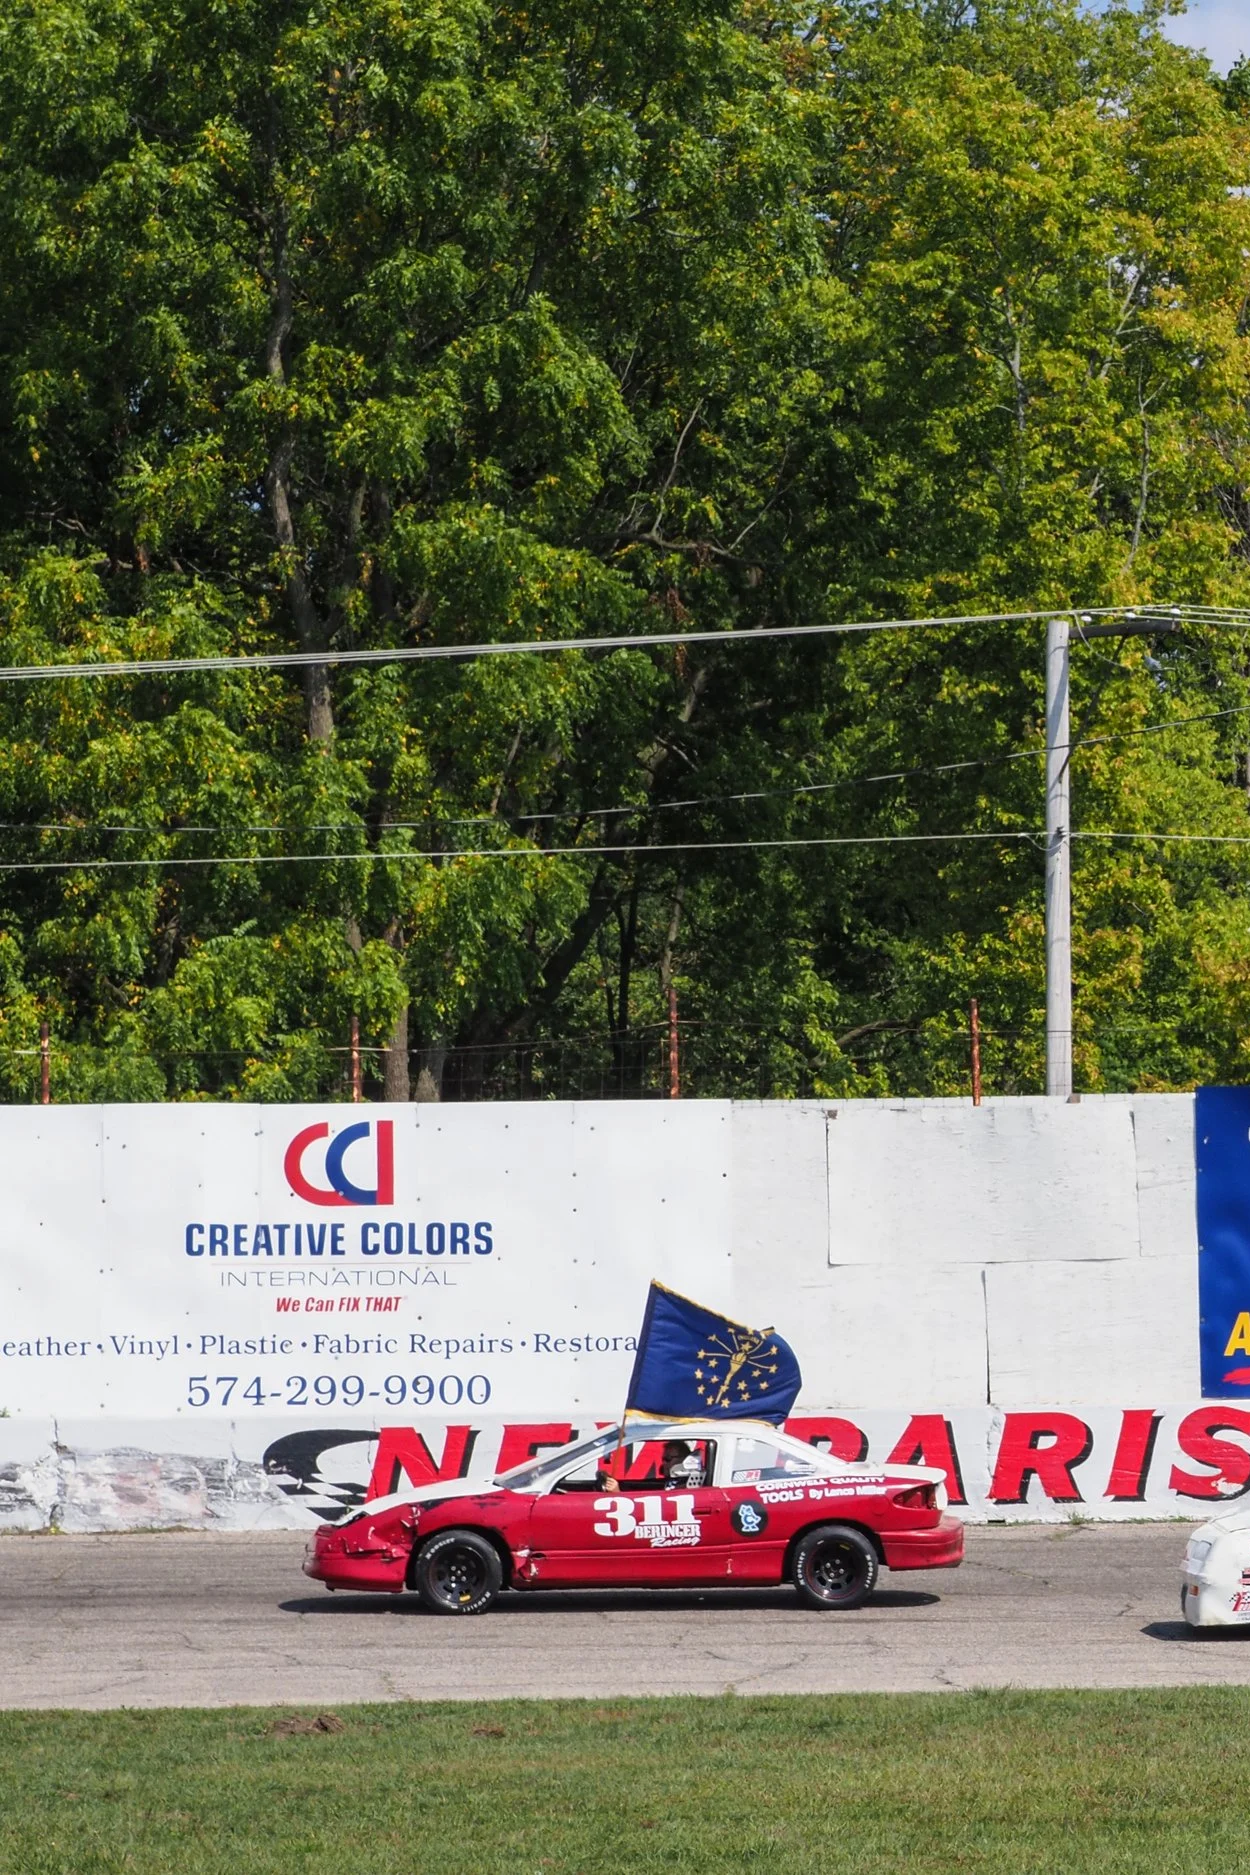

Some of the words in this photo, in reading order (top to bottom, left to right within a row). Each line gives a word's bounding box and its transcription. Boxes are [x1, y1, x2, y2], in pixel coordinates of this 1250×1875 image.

[185, 1222, 346, 1256] CREATIVE
[360, 1221, 494, 1256] COLORS
[220, 1269, 458, 1287] INTERNATIONAL
[276, 1296, 301, 1313] We
[304, 1296, 334, 1312] Can
[338, 1296, 361, 1311] FIX
[365, 1295, 403, 1311] THAT
[1, 1335, 92, 1358] eather
[109, 1334, 180, 1361] Vinyl
[199, 1333, 294, 1355] Plastic
[312, 1332, 399, 1354] Fabric
[408, 1332, 513, 1360] Repairs
[533, 1332, 639, 1353] Restora
[187, 1374, 492, 1408] 574-299-9900
[759, 1488, 805, 1504] TOOLS
[593, 1494, 702, 1536] 311
